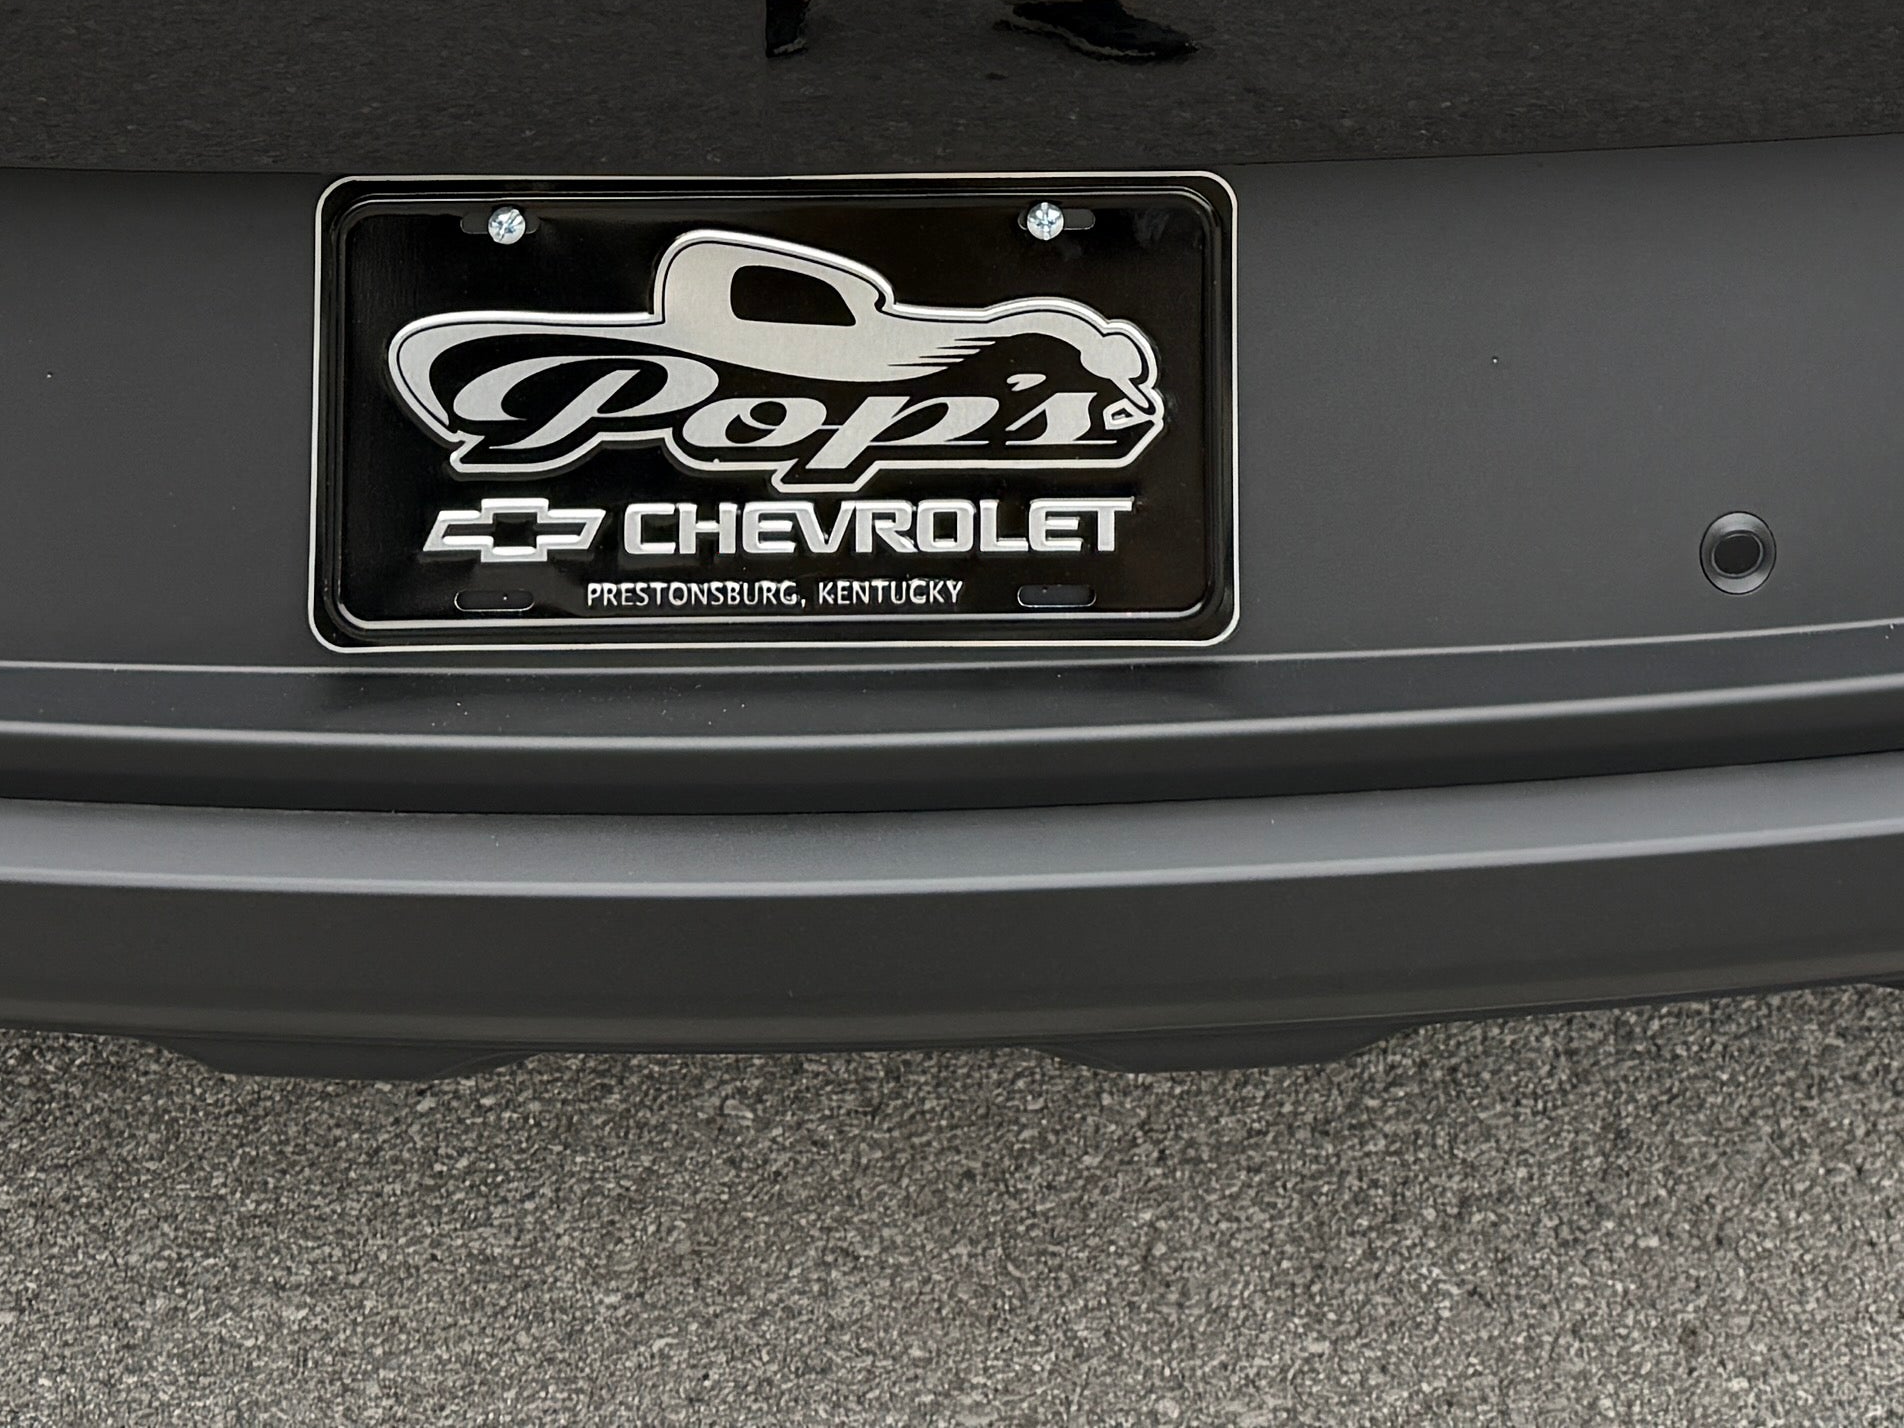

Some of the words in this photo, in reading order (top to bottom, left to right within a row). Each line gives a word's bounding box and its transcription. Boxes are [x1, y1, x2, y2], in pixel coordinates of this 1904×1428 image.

[453, 355, 1118, 470] Pop's
[623, 497, 1136, 557] CHEVROLET
[586, 581, 809, 610] PRESTONSBURG,
[817, 580, 965, 608] KENTUCKY
